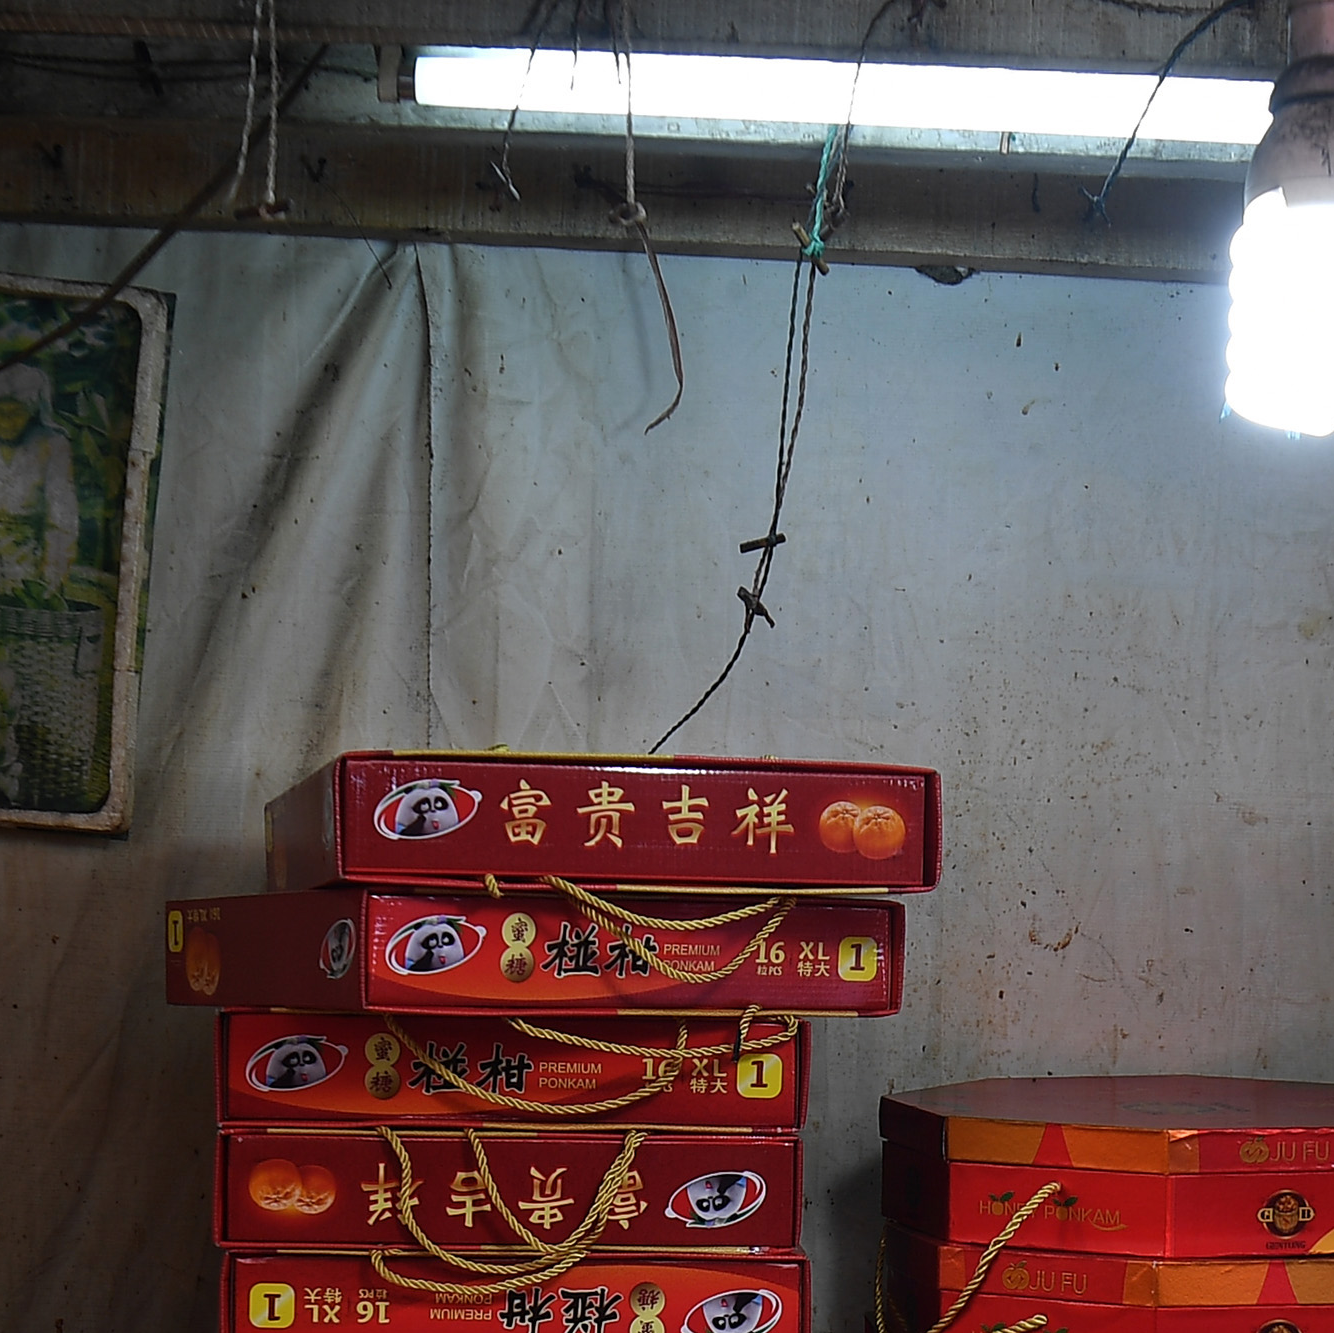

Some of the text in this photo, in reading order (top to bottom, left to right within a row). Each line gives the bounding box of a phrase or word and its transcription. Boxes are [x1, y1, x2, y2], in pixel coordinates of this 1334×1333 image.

[501, 779, 795, 855] 富贵吉祥
[503, 915, 531, 978] 蜜糖
[663, 943, 721, 957] PREMIUM
[755, 940, 832, 964] 16 XL
[848, 942, 866, 972] 1
[796, 960, 832, 978] 特大
[538, 1061, 603, 1075] PREMIUM
[691, 1058, 728, 1078] XL
[750, 1060, 769, 1088] 1
[538, 1076, 597, 1090] PONKAM
[689, 1078, 729, 1095] 特大
[1270, 1139, 1331, 1165] JU FU
[1028, 1270, 1088, 1295] JU FU
[265, 1291, 282, 1321] 1
[304, 1287, 344, 1304] 特大
[434, 1291, 494, 1305] PONKAM
[305, 1300, 391, 1325] 16 XL
[429, 1307, 494, 1320] PREMIUM
